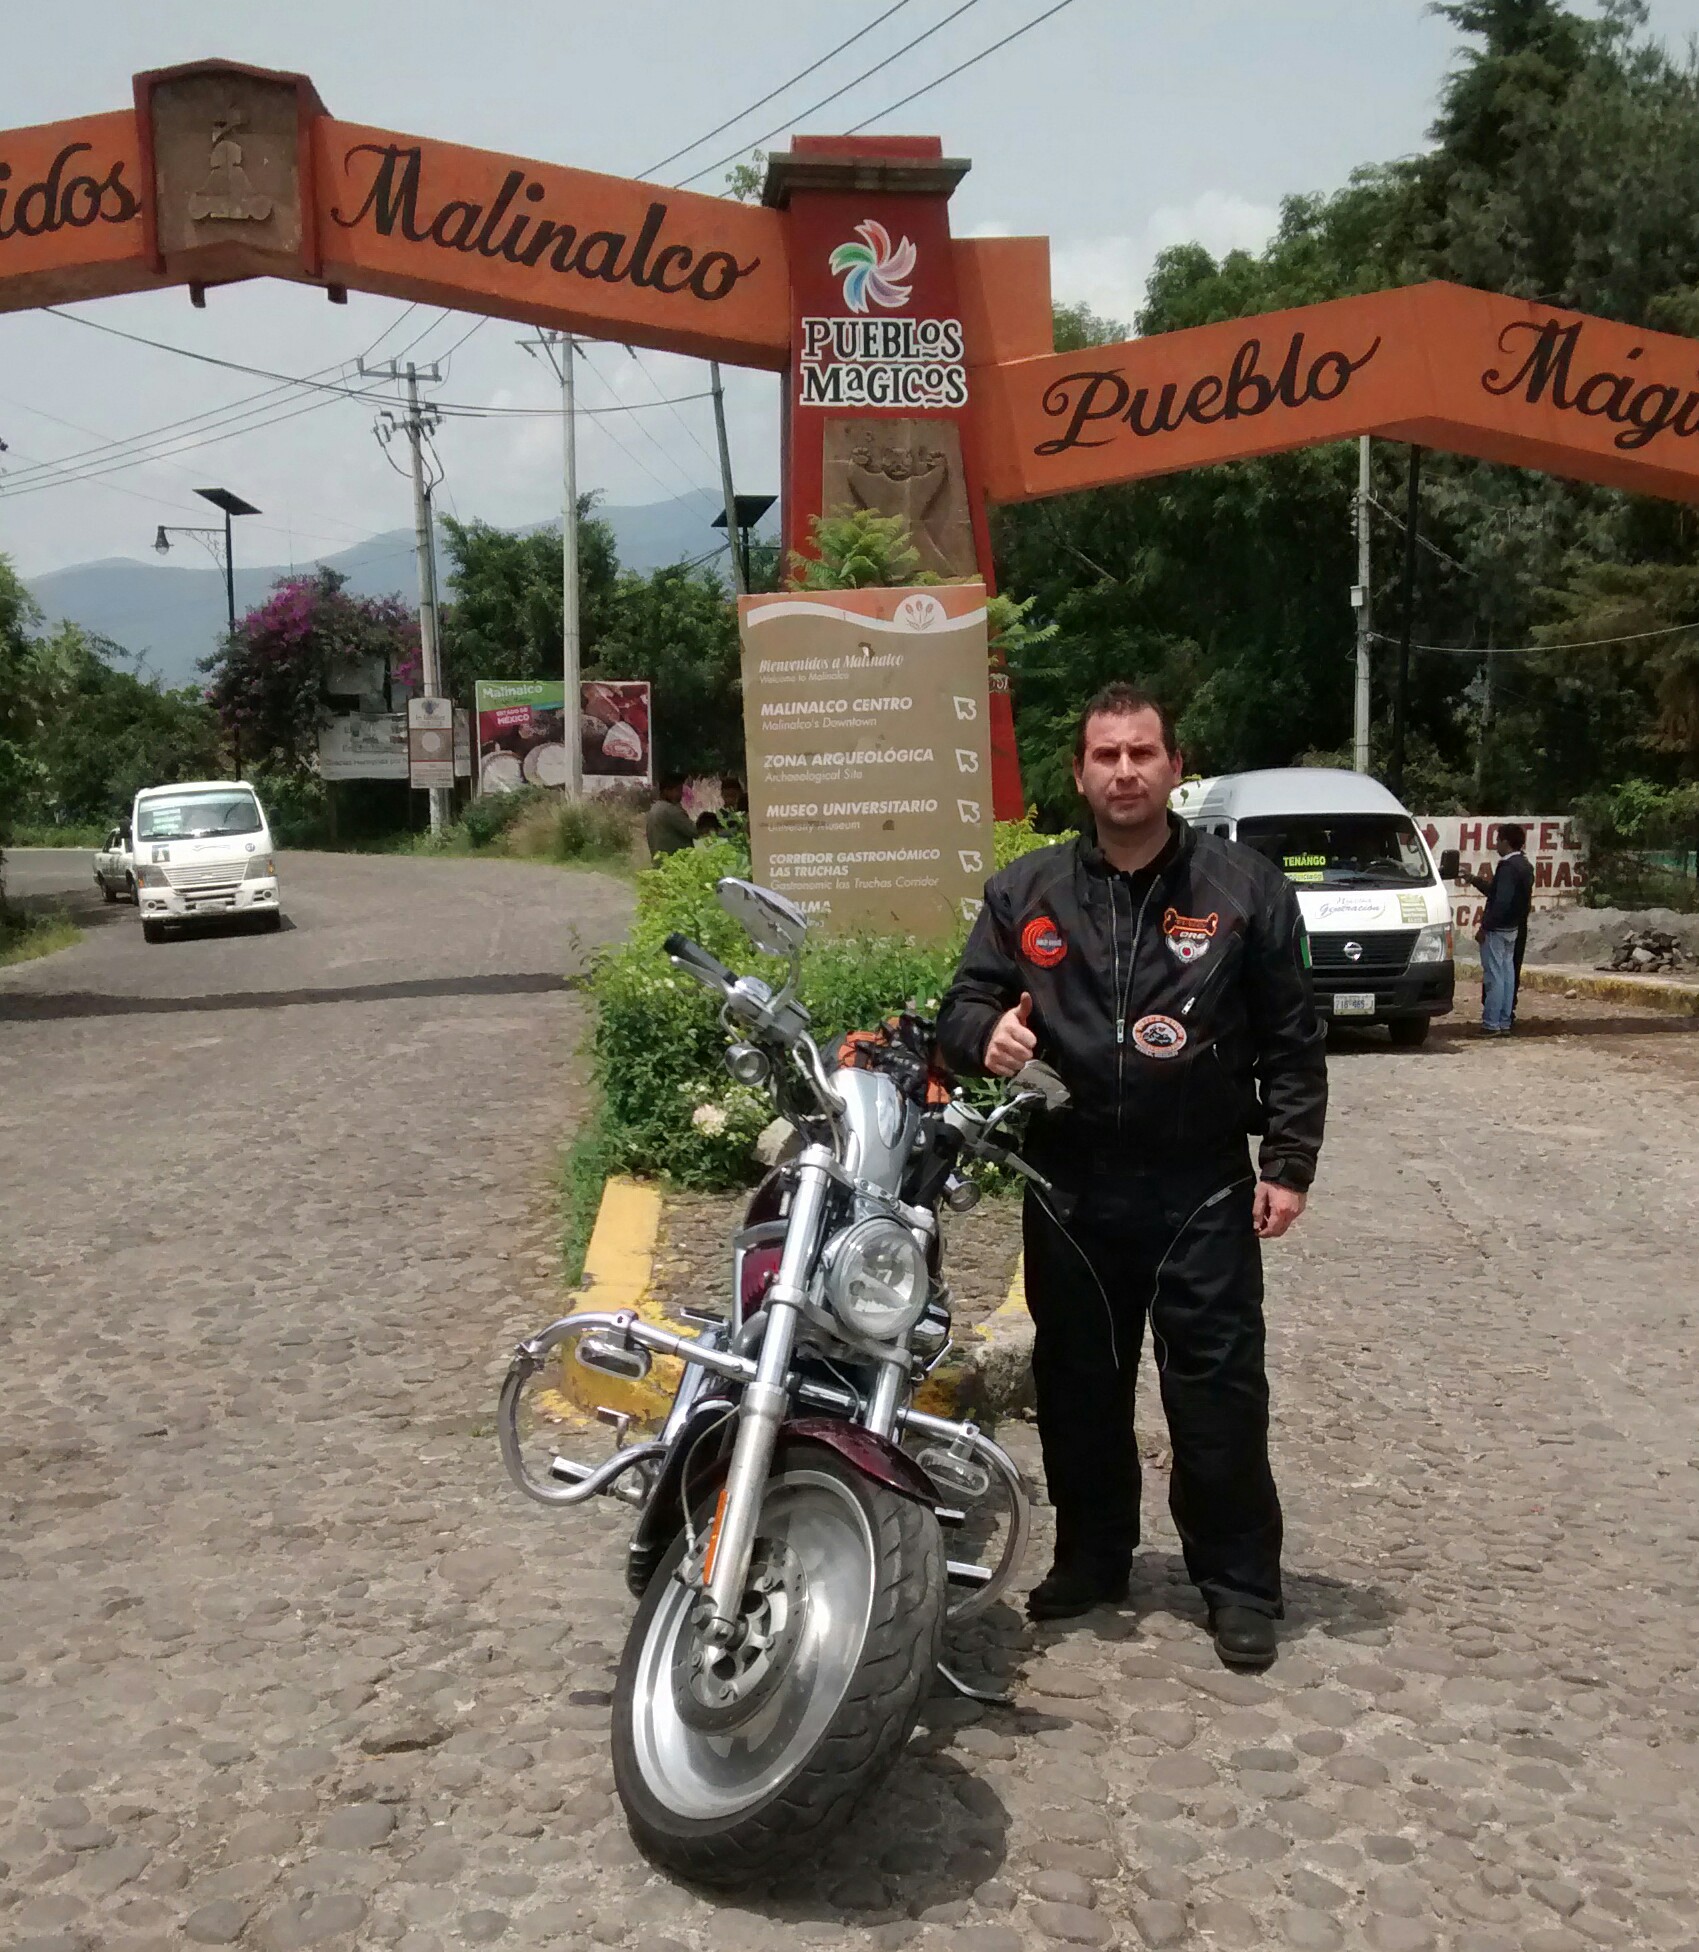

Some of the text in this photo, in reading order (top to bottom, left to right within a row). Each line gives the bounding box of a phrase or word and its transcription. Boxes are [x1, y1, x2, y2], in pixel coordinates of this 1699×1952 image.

[331, 143, 760, 301] Malinalco
[1033, 331, 1382, 456] Pueblo
[758, 653, 904, 673] Bienvenidos a Malinalco
[482, 684, 543, 699] Malinalco
[761, 697, 913, 716] MALINALCO CENTRO
[762, 717, 877, 731] Malinalco's Downtown
[763, 747, 935, 768] ZONA ARQUEOLÓGICA
[766, 799, 938, 818] MUSEO UNIVERSITARIO
[769, 847, 941, 864] CORREDOR GASTRONÓMICO
[770, 866, 849, 877] LAS TRUCHAS
[770, 875, 940, 891] Gastronomic las Truchas Corridor
